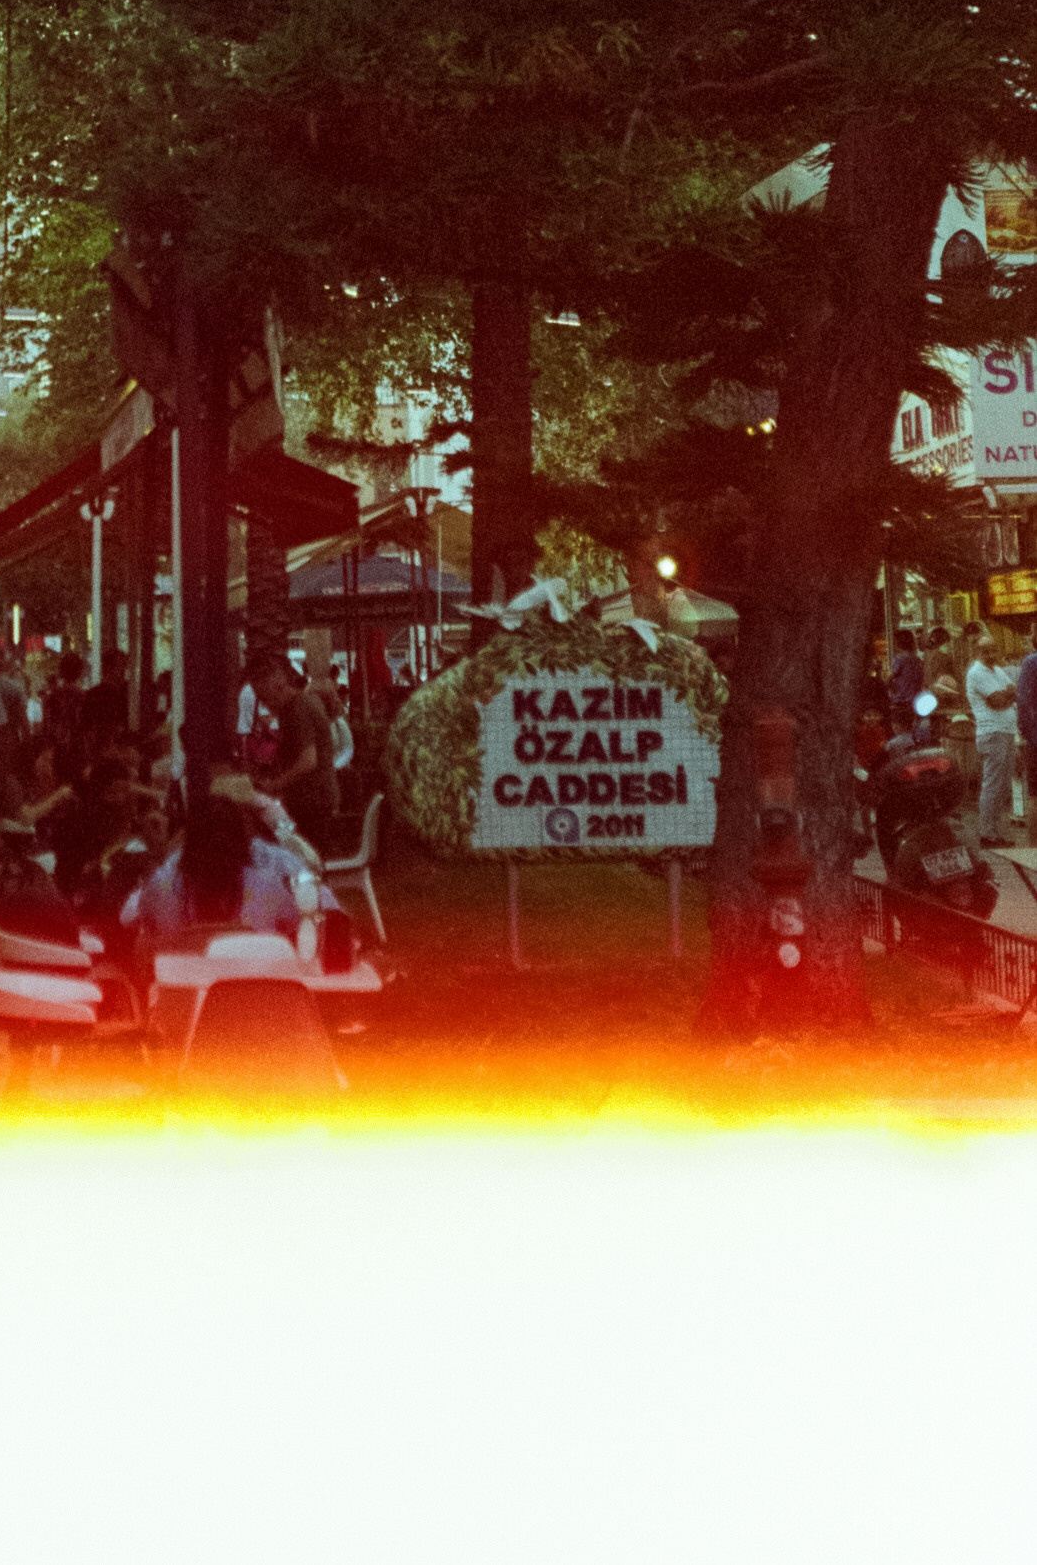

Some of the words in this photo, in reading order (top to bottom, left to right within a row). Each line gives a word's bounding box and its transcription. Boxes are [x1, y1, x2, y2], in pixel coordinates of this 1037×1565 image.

[513, 687, 663, 722] KAZIM
[513, 724, 664, 765] ÖZALP
[492, 765, 689, 808] CADDESİ
[586, 813, 646, 838] 2011
